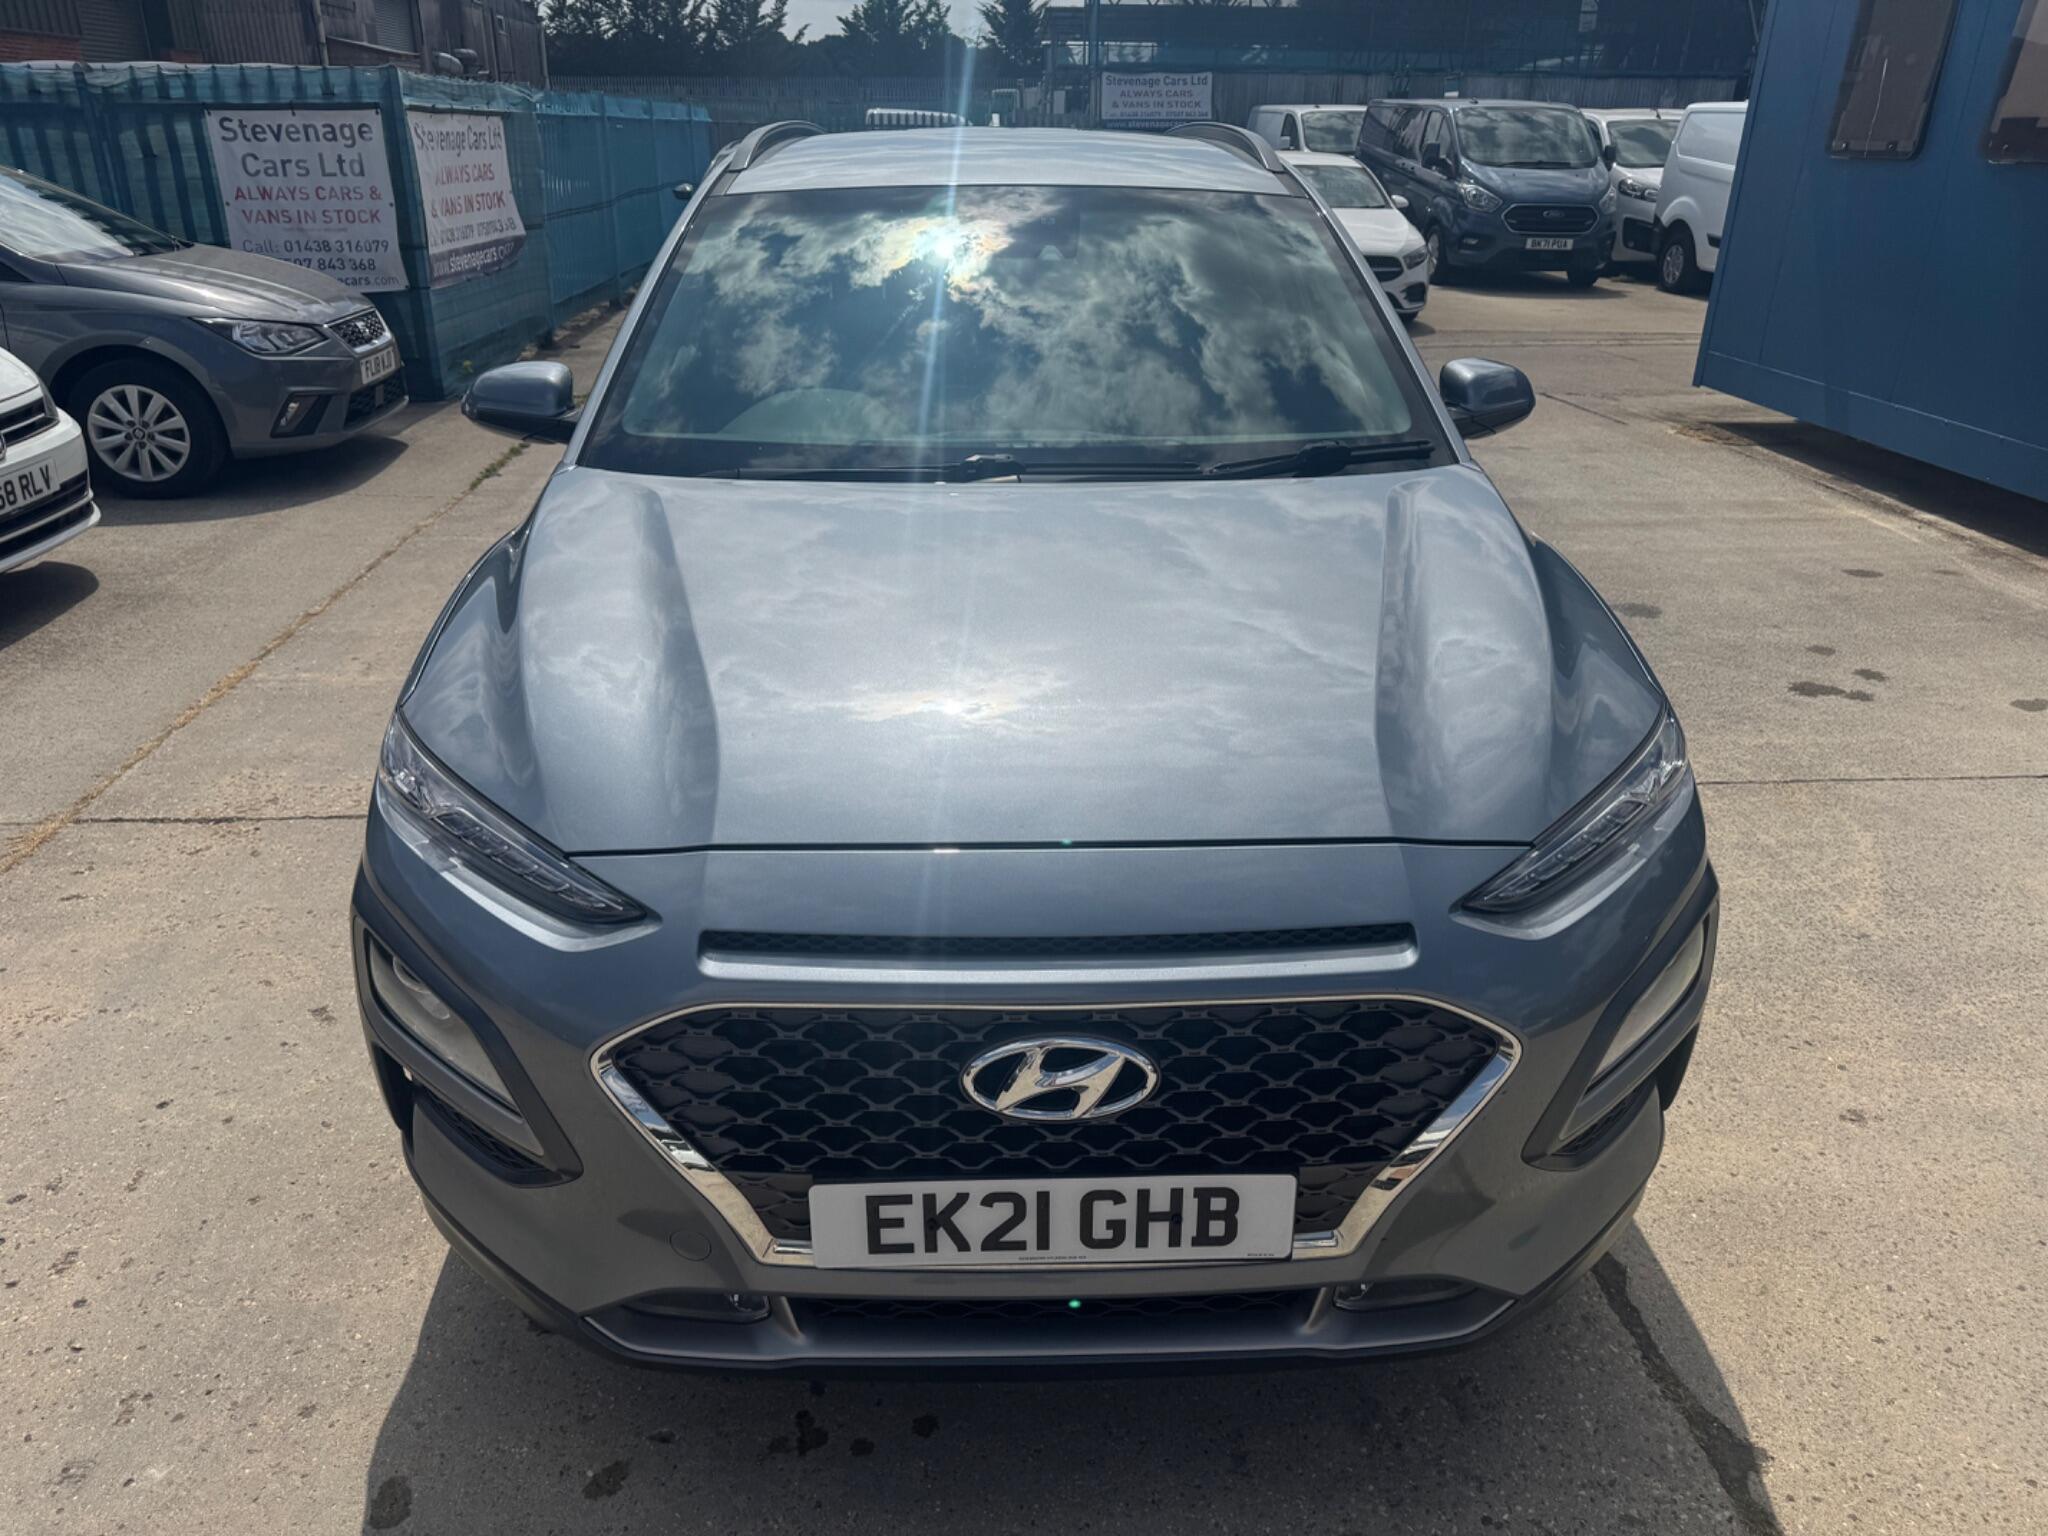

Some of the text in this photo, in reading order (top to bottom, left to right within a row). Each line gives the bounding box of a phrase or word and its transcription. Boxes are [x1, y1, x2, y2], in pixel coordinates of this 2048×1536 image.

[1105, 75, 1208, 88] Stevenage Cars Ltd
[1120, 89, 1193, 98] ALWAYS CARS
[219, 116, 373, 148] Stevenage
[414, 122, 465, 157] Stevenage
[466, 124, 487, 151] Cars
[241, 152, 365, 177] Cars Ltd
[471, 163, 495, 182] CARS
[235, 185, 383, 200] ALWAYS CARS &
[242, 209, 381, 224] VANS IN STOCK
[284, 240, 331, 252] 01438
[336, 240, 389, 252] 316079
[317, 258, 346, 271] 843
[351, 258, 376, 271] 368
[19, 464, 51, 500] RLV
[865, 1186, 1239, 1254] EK21 GHB
